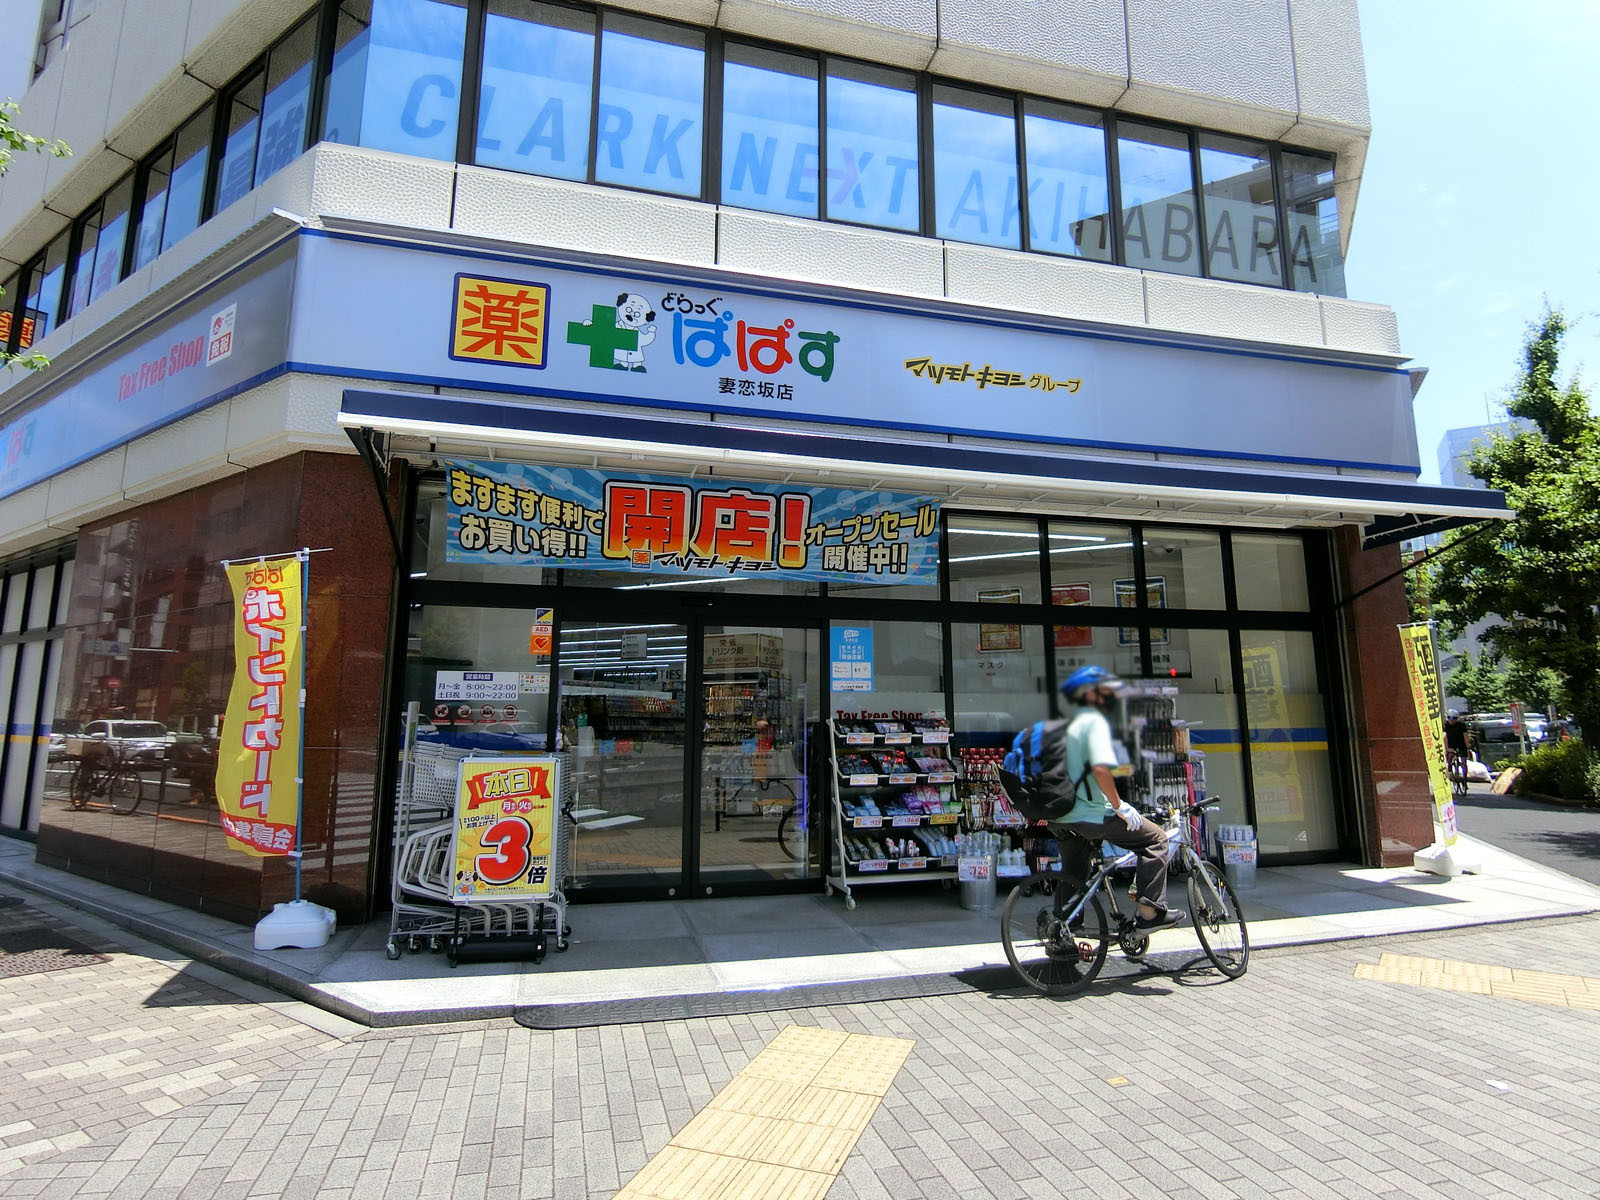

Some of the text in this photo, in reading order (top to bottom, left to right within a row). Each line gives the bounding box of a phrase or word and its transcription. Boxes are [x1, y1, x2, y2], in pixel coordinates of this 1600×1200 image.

[401, 75, 1319, 284] CLARK NEXT AKIHABARA
[661, 291, 723, 315] どらっぐ
[463, 285, 841, 383] 薬 ぱぱす
[119, 335, 205, 402] Tax Free Shop
[718, 377, 794, 400] 妻恋坂店
[451, 470, 606, 535] ますます便利で
[459, 514, 588, 558] お買い得!!
[804, 504, 937, 546] オープンセール
[653, 551, 778, 574] マツモトキヨシ
[484, 770, 531, 797] 本日
[476, 815, 533, 886] 3
[527, 865, 548, 885] 倍
